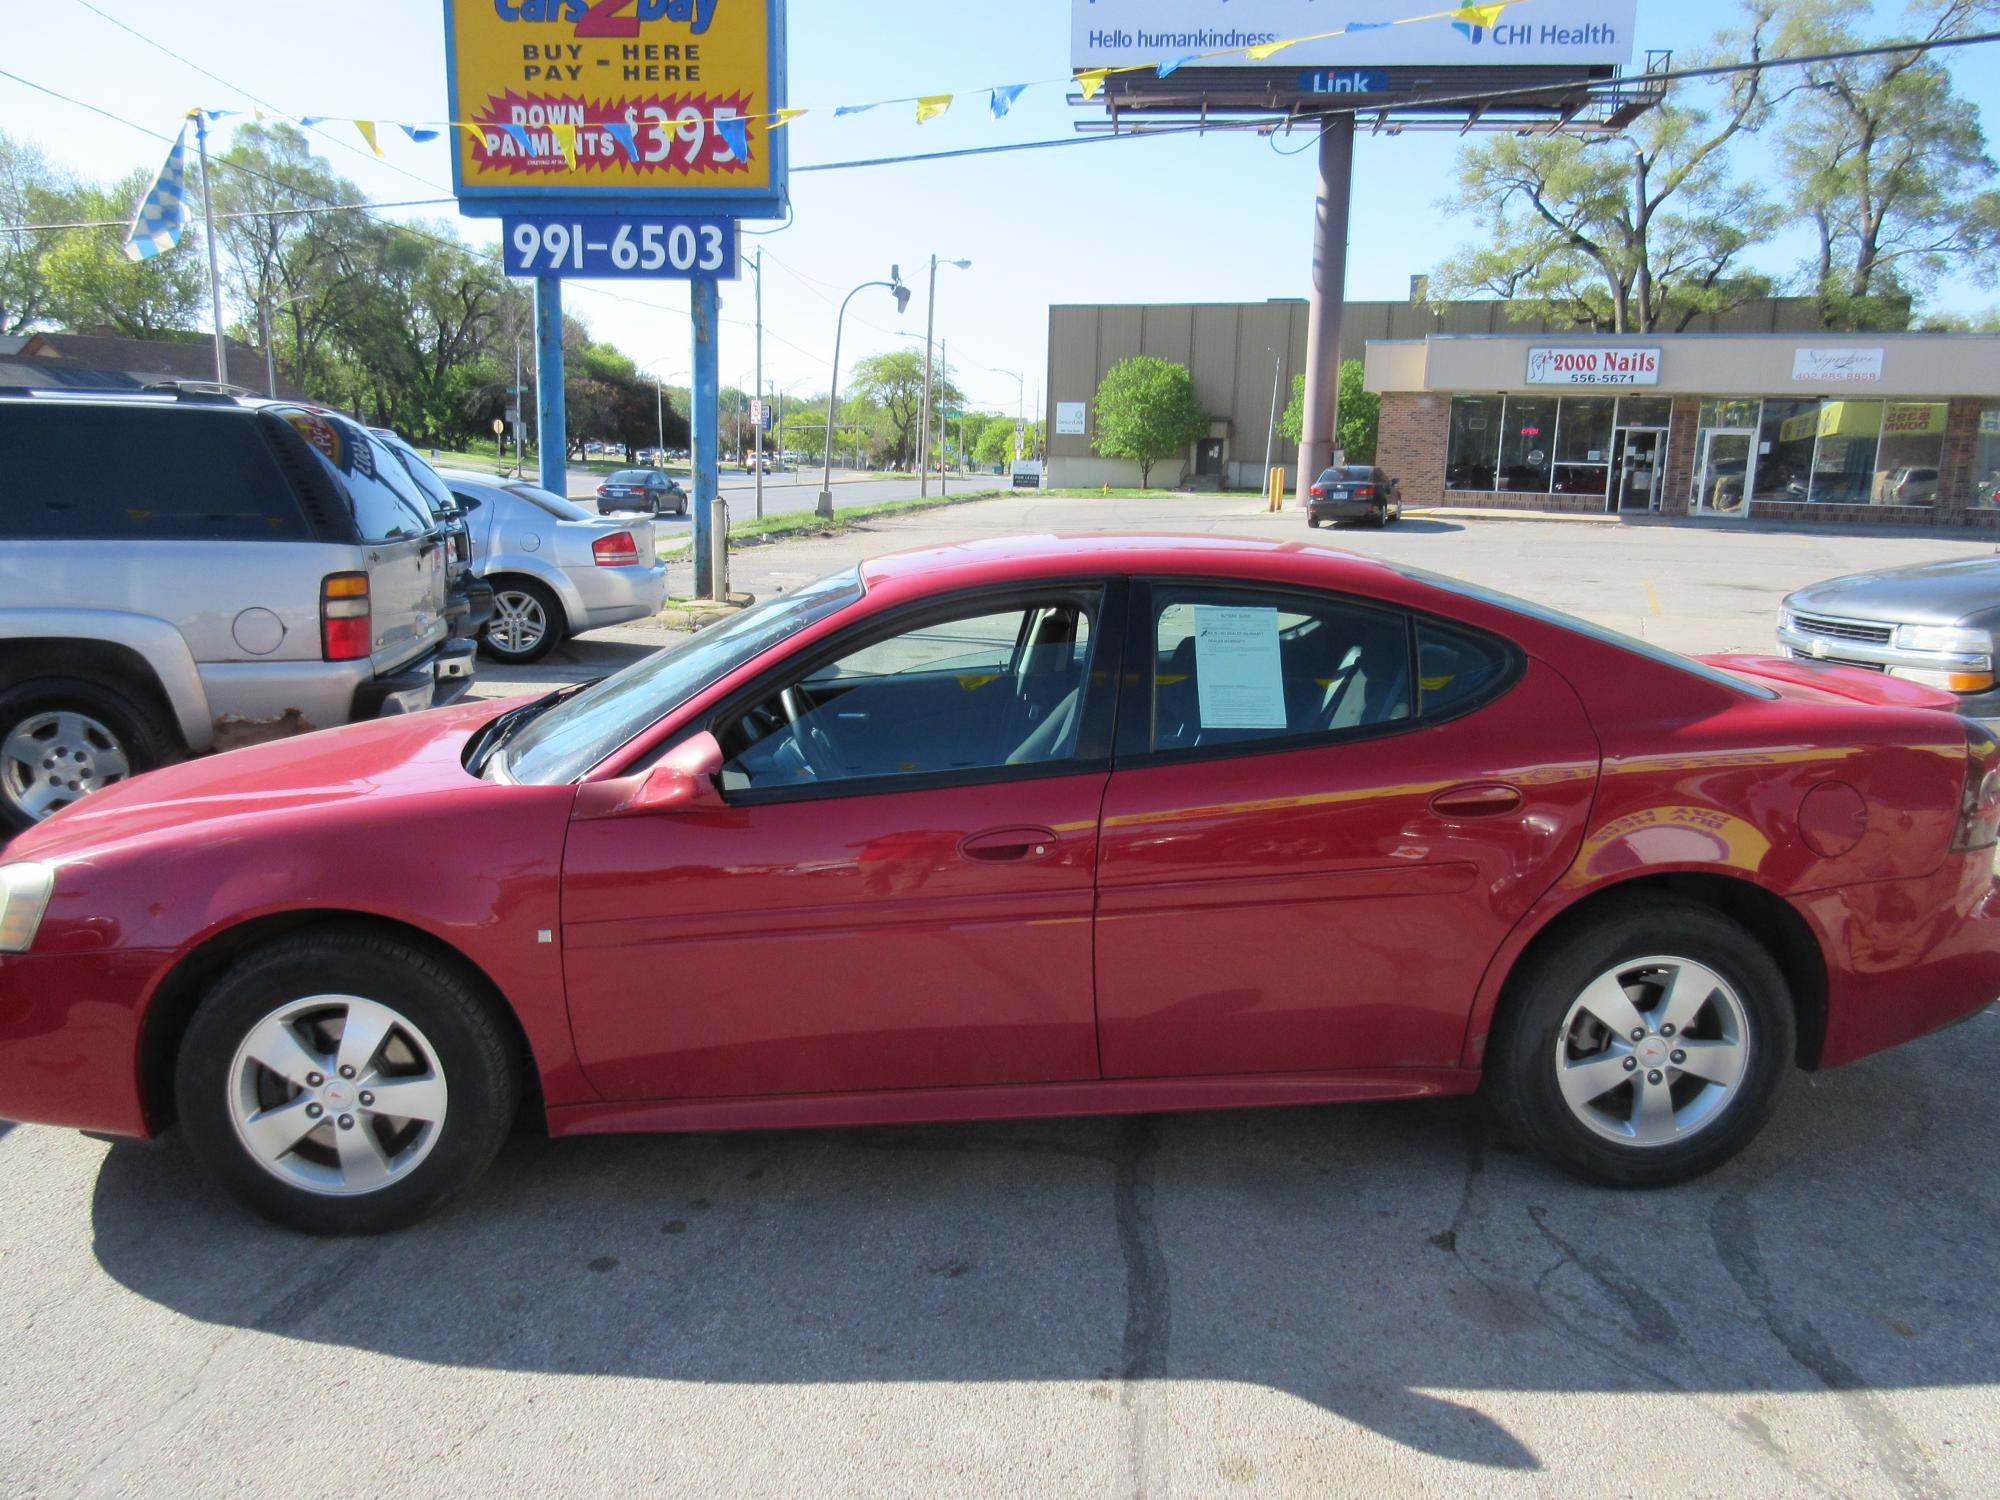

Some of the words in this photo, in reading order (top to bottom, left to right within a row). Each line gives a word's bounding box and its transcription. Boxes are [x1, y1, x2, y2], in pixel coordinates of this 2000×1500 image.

[1089, 29, 1132, 48] Hello
[1137, 28, 1275, 48] humankindness
[1492, 24, 1532, 45] CHI
[1540, 22, 1616, 45] Health
[523, 44, 584, 60] BUY
[622, 44, 700, 60] HERE
[524, 65, 584, 81] PAY
[623, 65, 700, 81] HERE
[1313, 72, 1370, 93] Link
[511, 104, 585, 129] DOWN
[624, 105, 740, 164] $395
[513, 223, 724, 270] 991-6503
[1553, 354, 1597, 372] 2000
[1603, 352, 1655, 372] Nails
[1570, 374, 1635, 383] 556-5671
